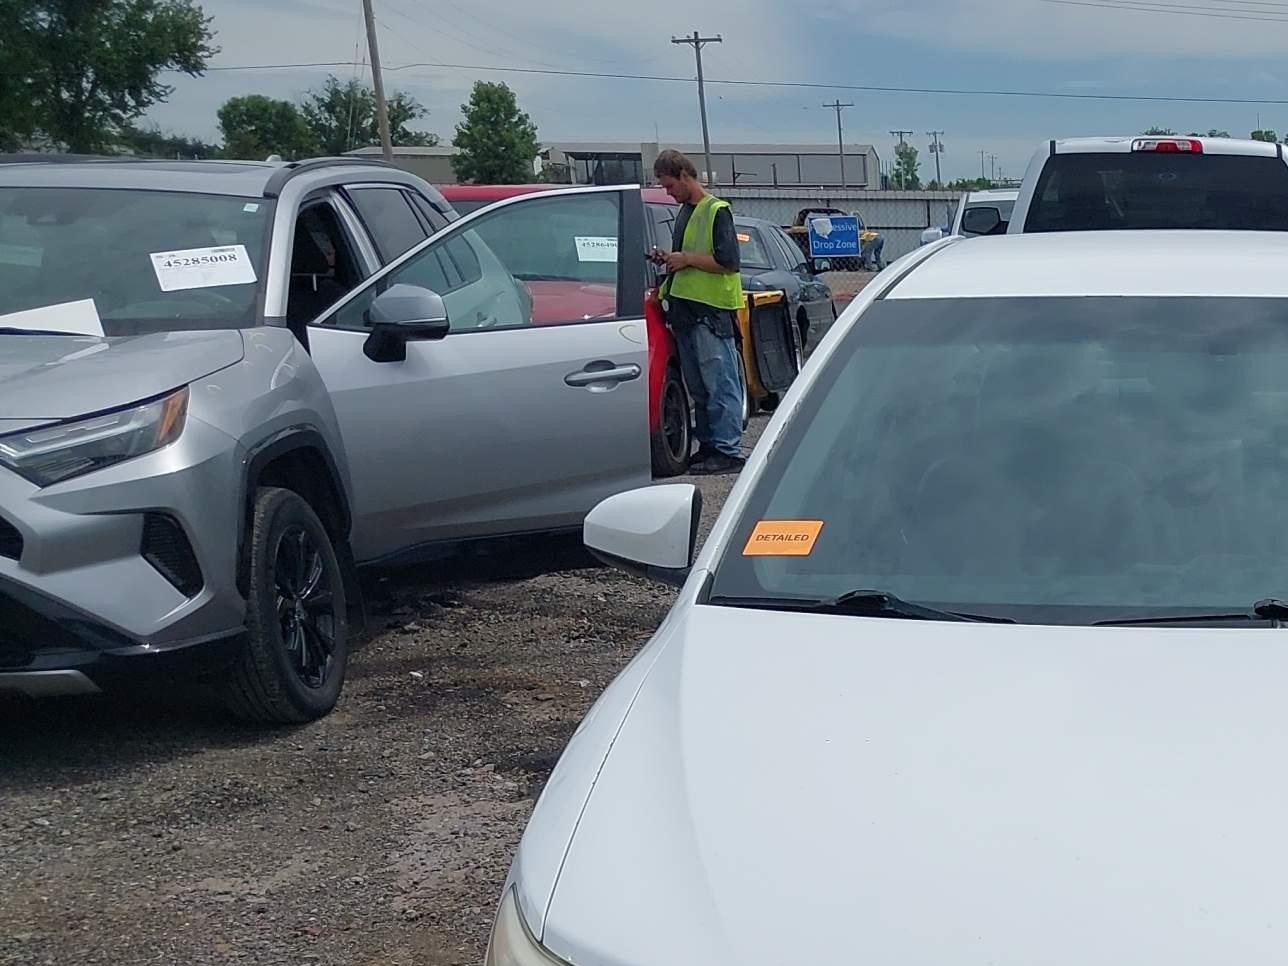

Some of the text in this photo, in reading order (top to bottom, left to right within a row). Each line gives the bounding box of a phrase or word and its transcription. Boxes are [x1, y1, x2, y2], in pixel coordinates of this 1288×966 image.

[831, 222, 858, 231] essive
[813, 240, 857, 250] Drop Zone
[163, 254, 238, 267] 45285008
[755, 534, 810, 542] DETAILED
